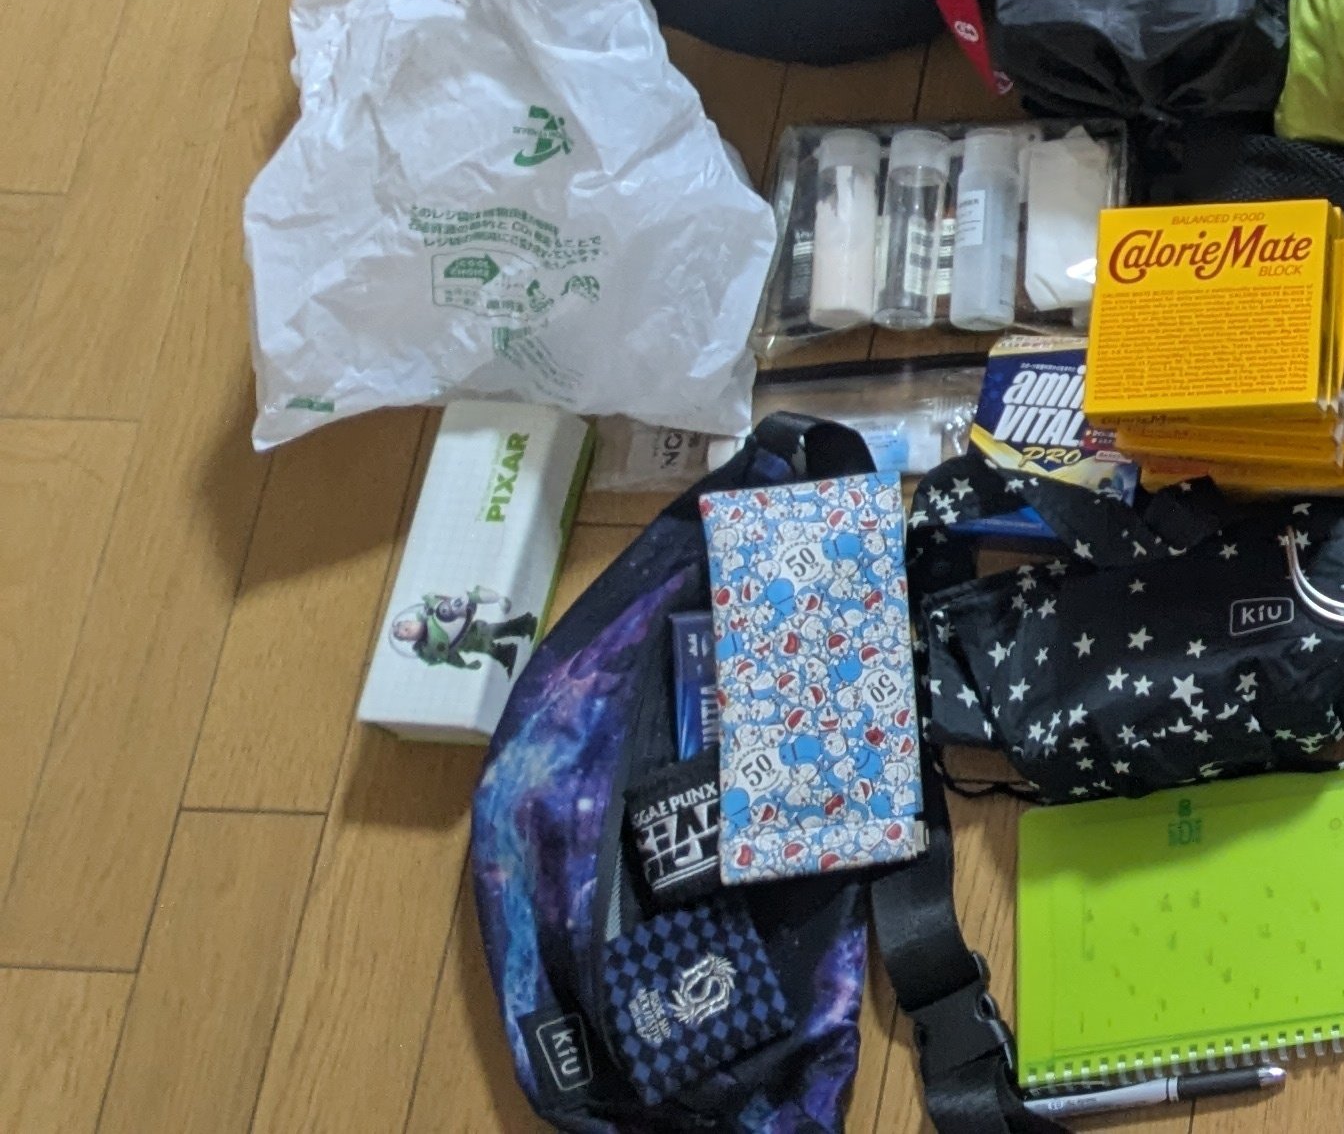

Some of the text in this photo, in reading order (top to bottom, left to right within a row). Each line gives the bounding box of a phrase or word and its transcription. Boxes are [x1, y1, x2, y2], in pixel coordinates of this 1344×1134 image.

[1171, 212, 1265, 225] BALANCED FOOD
[1258, 265, 1302, 277] BLOCK
[1002, 365, 1087, 409] ami
[993, 405, 1084, 447] VITAL
[1018, 446, 1082, 467] PRO
[486, 432, 530, 522] PIXAR
[785, 547, 816, 577] 50
[741, 754, 773, 786] 50
[668, 781, 718, 812] PUNX
